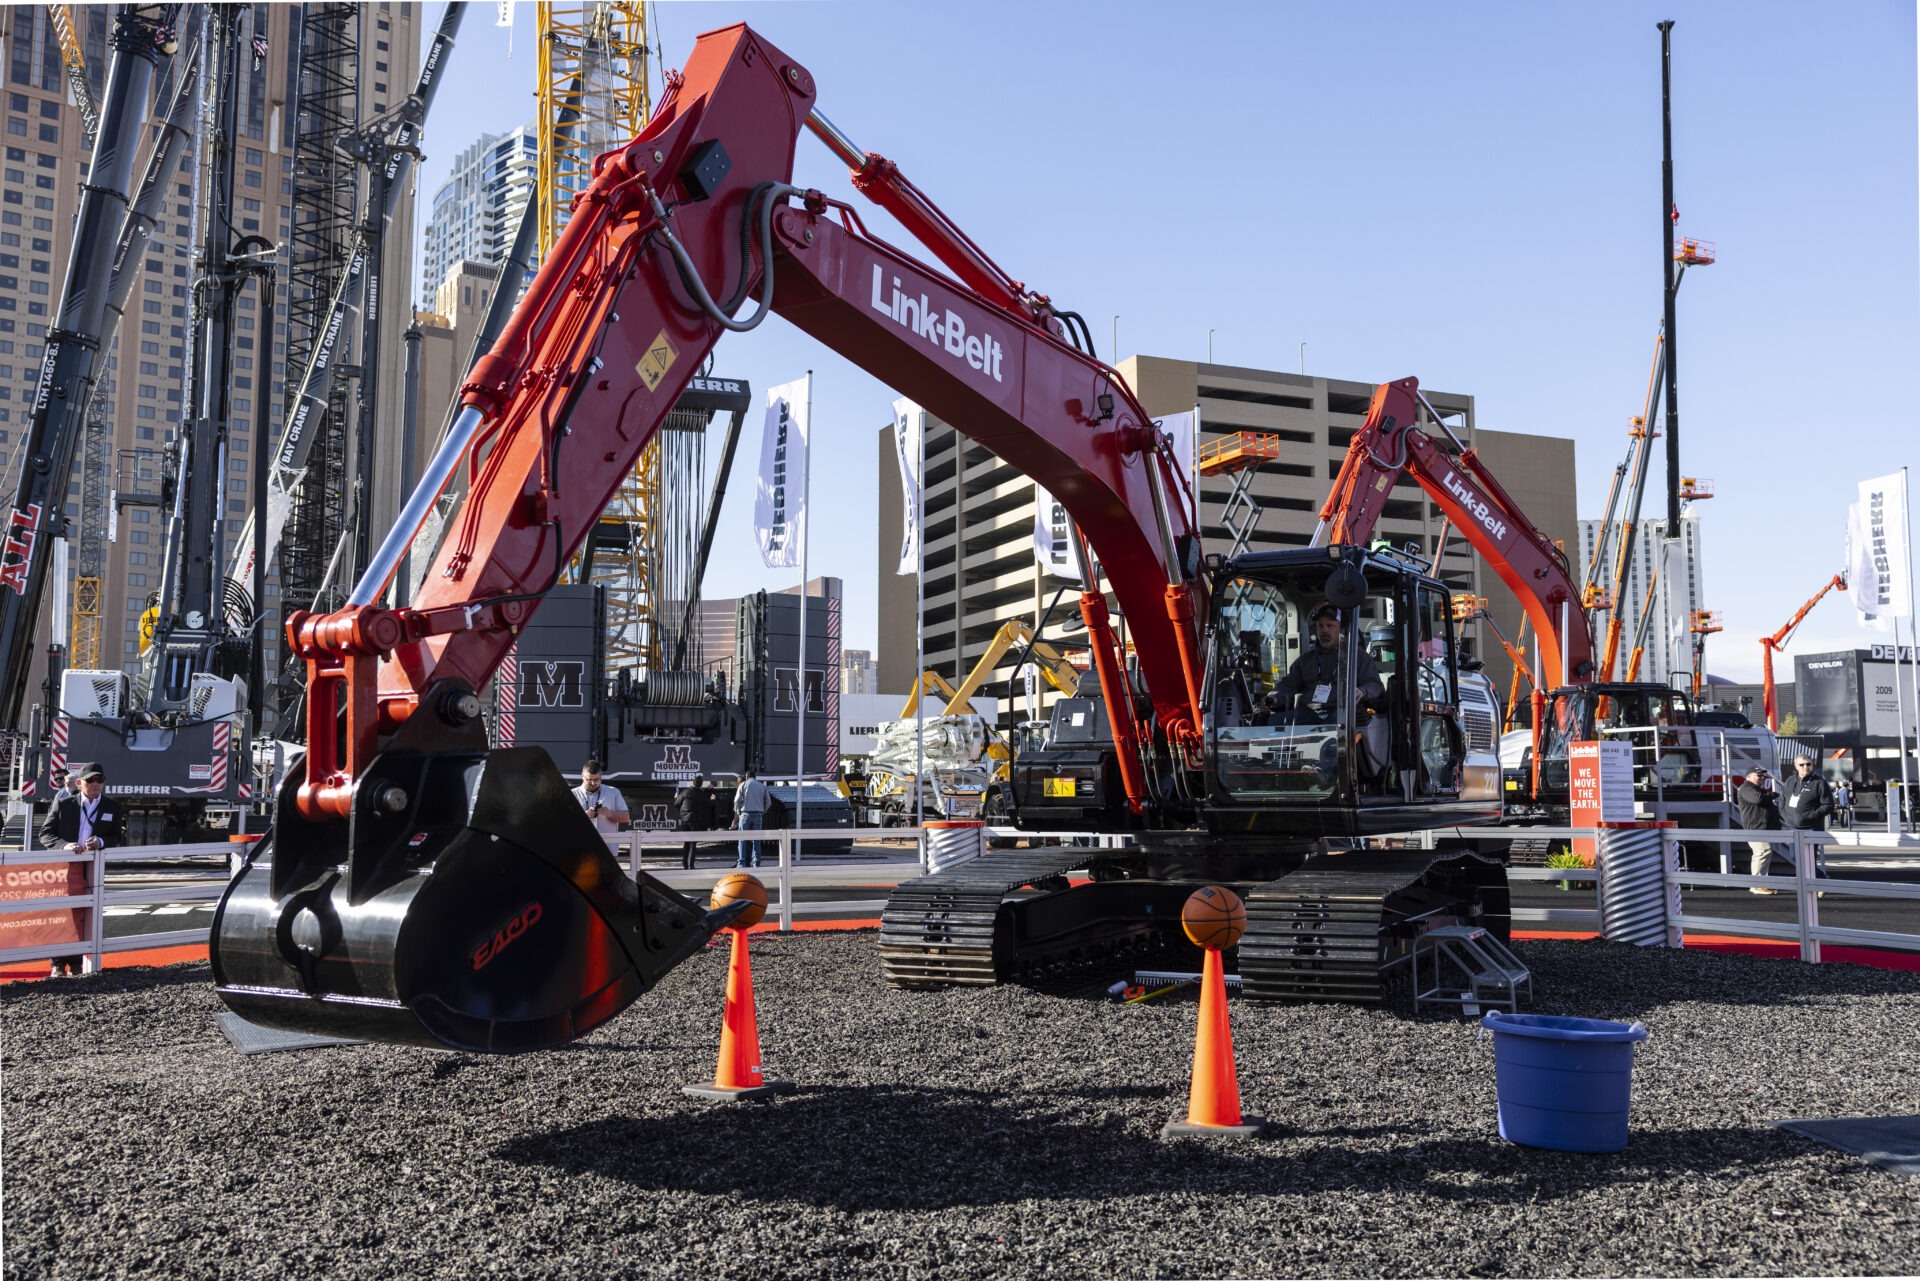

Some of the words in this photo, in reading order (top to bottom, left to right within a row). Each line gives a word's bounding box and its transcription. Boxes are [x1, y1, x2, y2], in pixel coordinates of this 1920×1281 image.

[422, 70, 432, 85] BAY
[428, 42, 443, 70] CRANE
[392, 130, 410, 162] CNE
[387, 162, 398, 180] BAY
[351, 255, 364, 275] BAY
[368, 276, 378, 321] LIEBHERR
[871, 263, 1003, 383] Link-Belt
[316, 349, 329, 369] BAY
[324, 311, 344, 348] CRANE
[43, 342, 60, 386] 1450-8.1
[37, 387, 51, 410] LTM
[282, 443, 295, 464] BAY
[289, 404, 309, 442] CRANE
[769, 401, 790, 551] LIEBHERR
[1442, 470, 1507, 541] Link-Belt
[0, 503, 43, 595] ALL
[1871, 491, 1891, 605] LIEBHERR
[1808, 660, 1843, 670] DEVELON
[519, 660, 585, 707] M
[774, 667, 826, 713] M
[1876, 686, 1893, 694] 2009
[655, 762, 699, 771] MOUNTAIN
[664, 745, 691, 763] M
[1574, 779, 1597, 788] MOVE
[1579, 768, 1591, 777] WE
[105, 785, 171, 795] LIEBHERR
[1578, 789, 1593, 798] THE
[643, 805, 667, 821] M
[1572, 800, 1600, 808] EARTH.
[634, 820, 676, 829] MOUNTAIN
[473, 903, 543, 971] EACO
